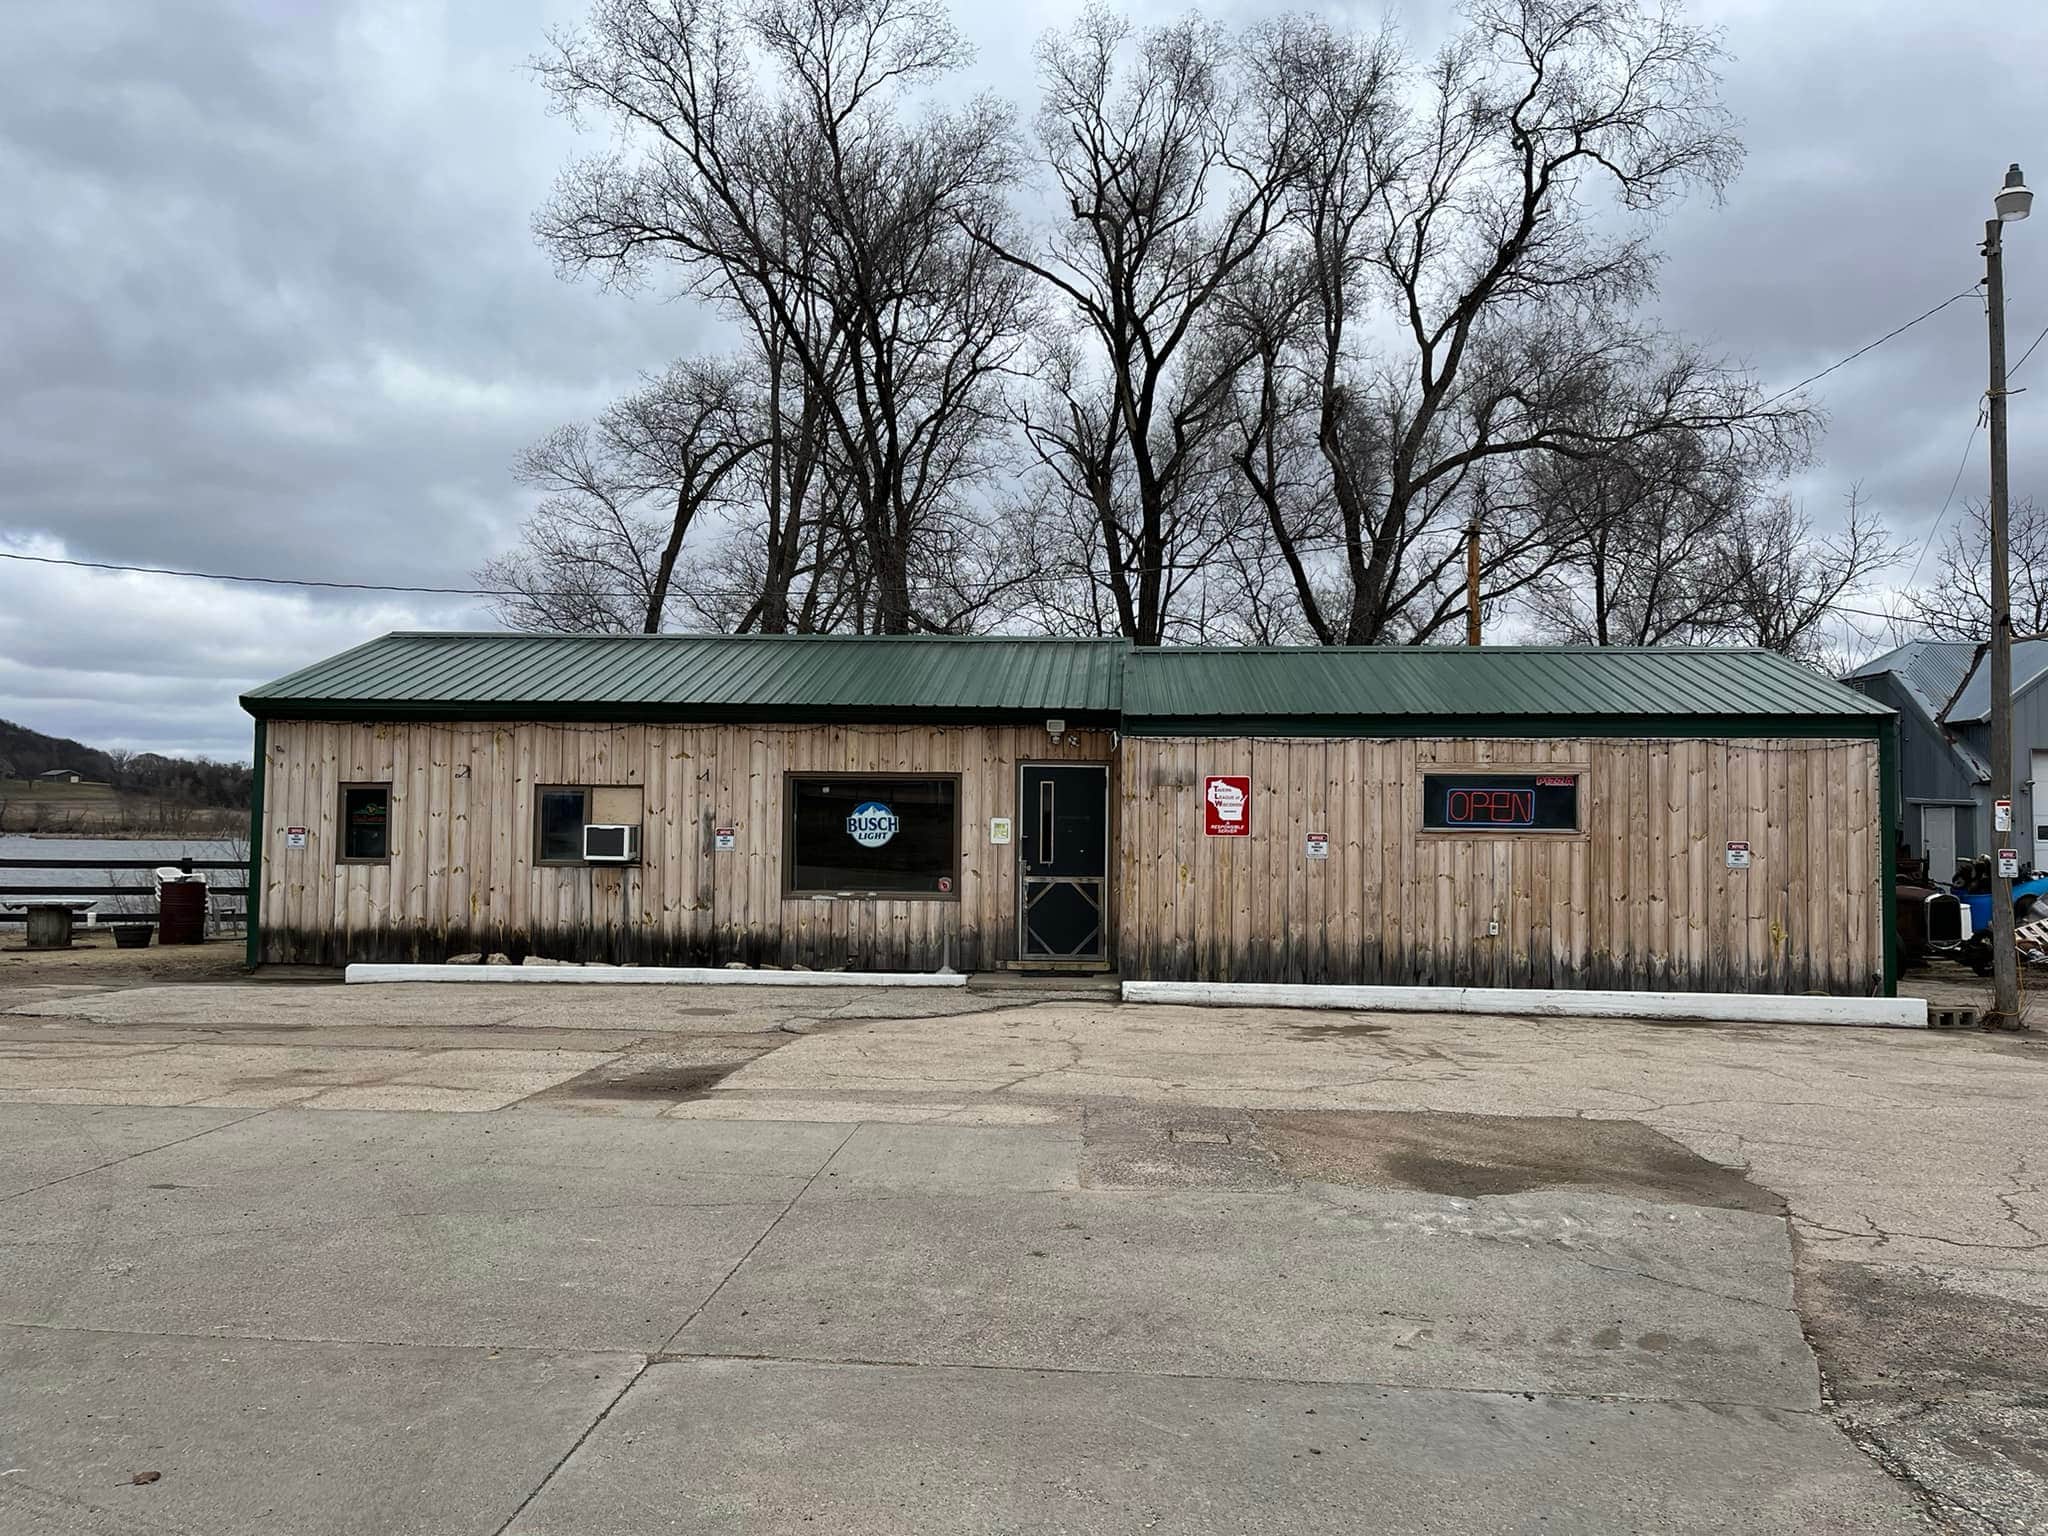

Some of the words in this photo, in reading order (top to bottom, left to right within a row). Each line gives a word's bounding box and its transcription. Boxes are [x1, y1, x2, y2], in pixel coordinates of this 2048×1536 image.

[1536, 776, 1574, 786] PIZZA
[1450, 792, 1531, 822] OPEN
[848, 817, 898, 832] BUSCH
[858, 832, 889, 840] LIGHT
